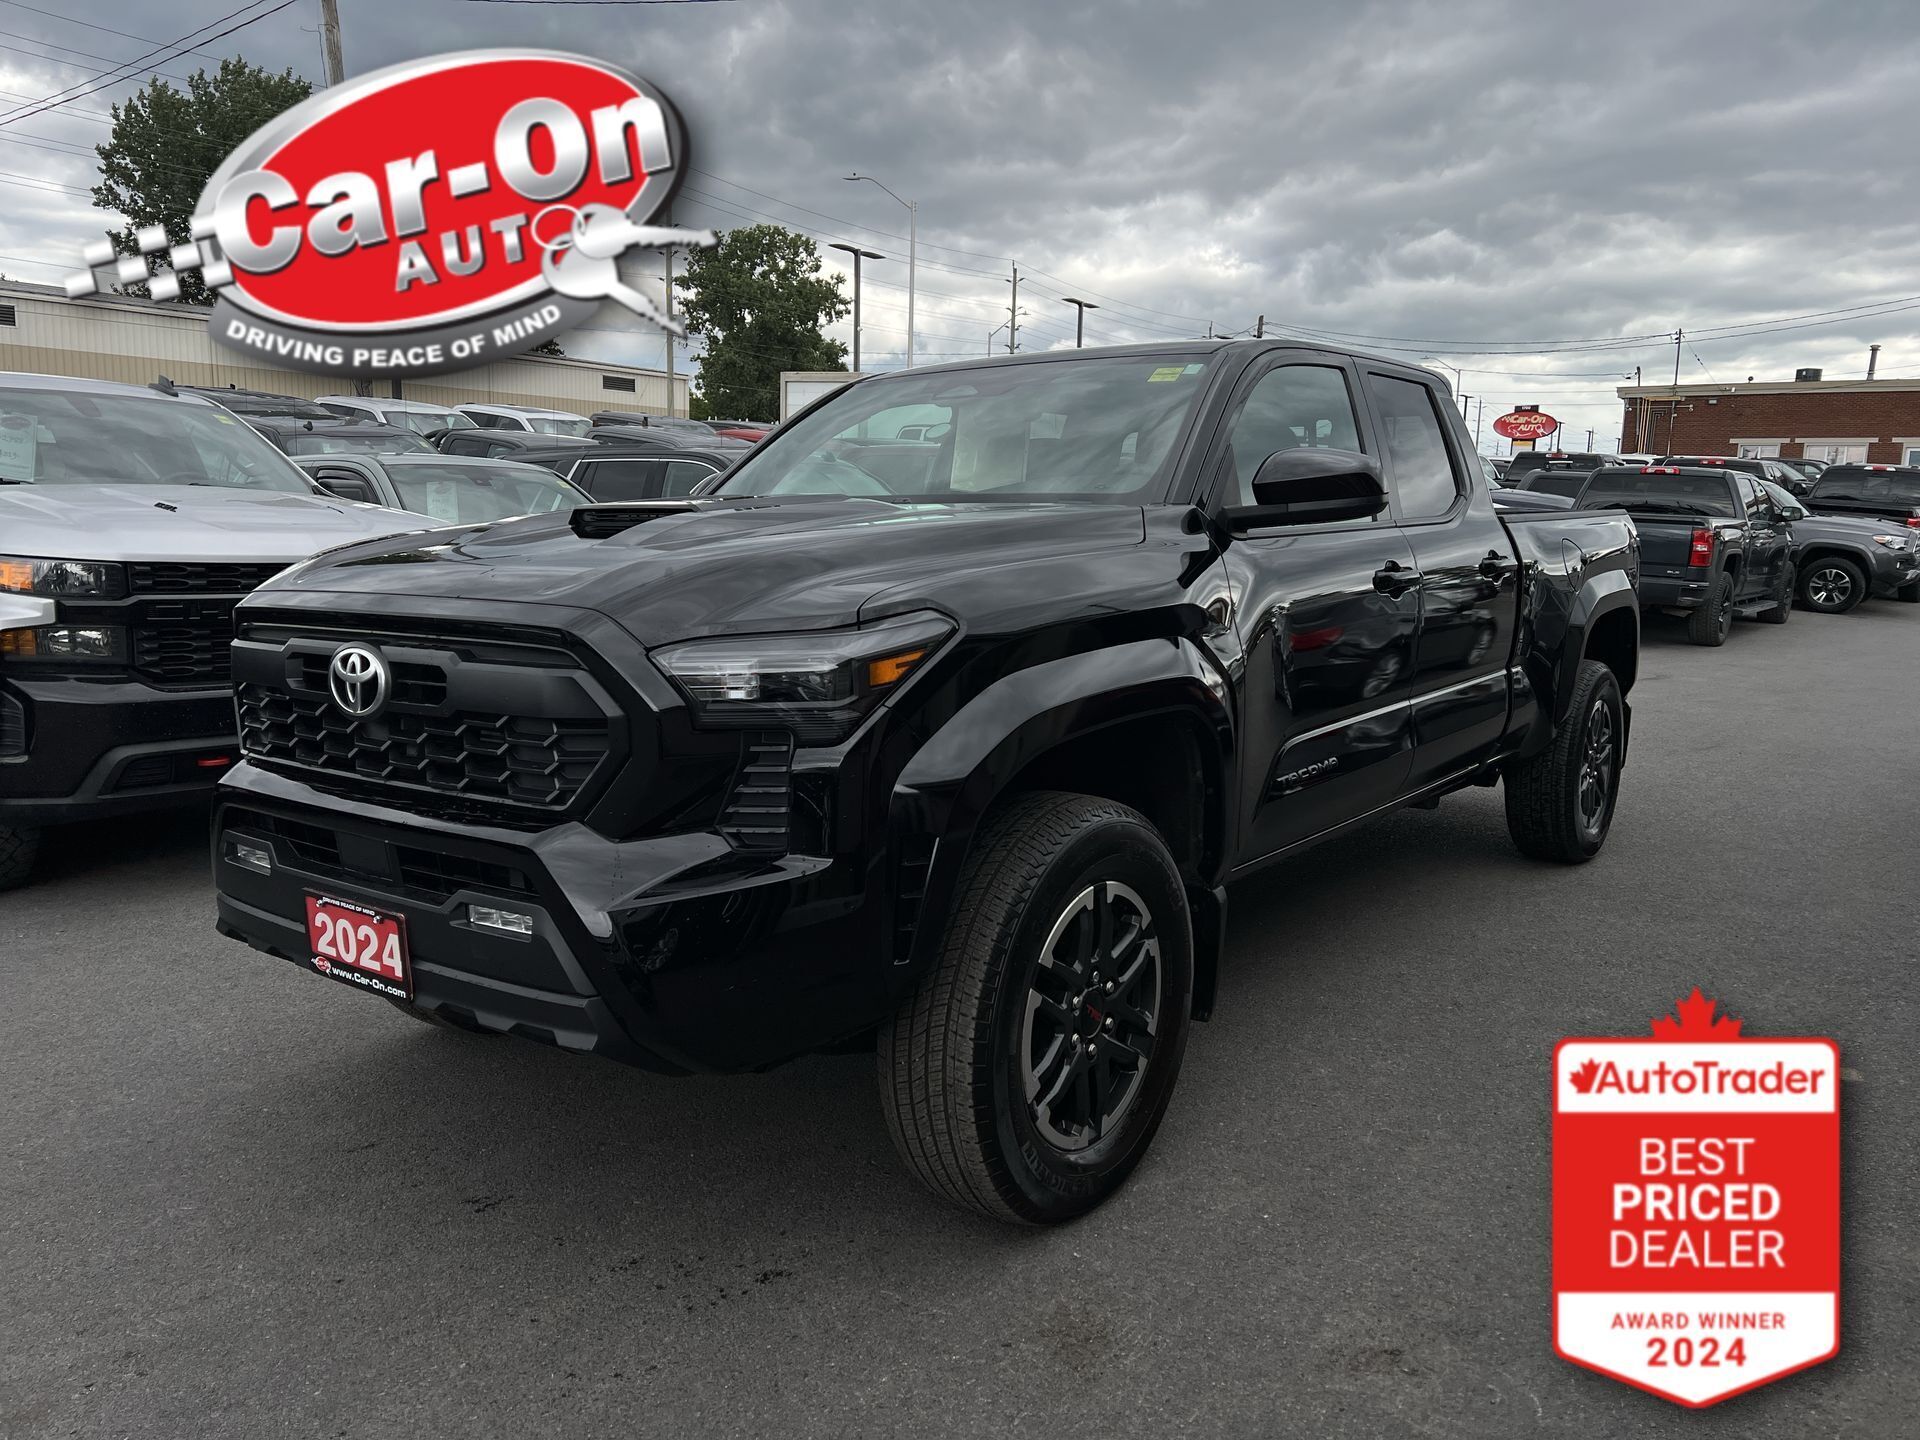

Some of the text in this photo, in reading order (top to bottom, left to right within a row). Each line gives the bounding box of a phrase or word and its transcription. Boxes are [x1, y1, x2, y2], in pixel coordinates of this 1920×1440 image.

[1511, 415, 1547, 423] Car-On
[362, 908, 375, 916] MIND
[314, 911, 403, 978] 2024
[332, 966, 406, 999] www.Car-On.com
